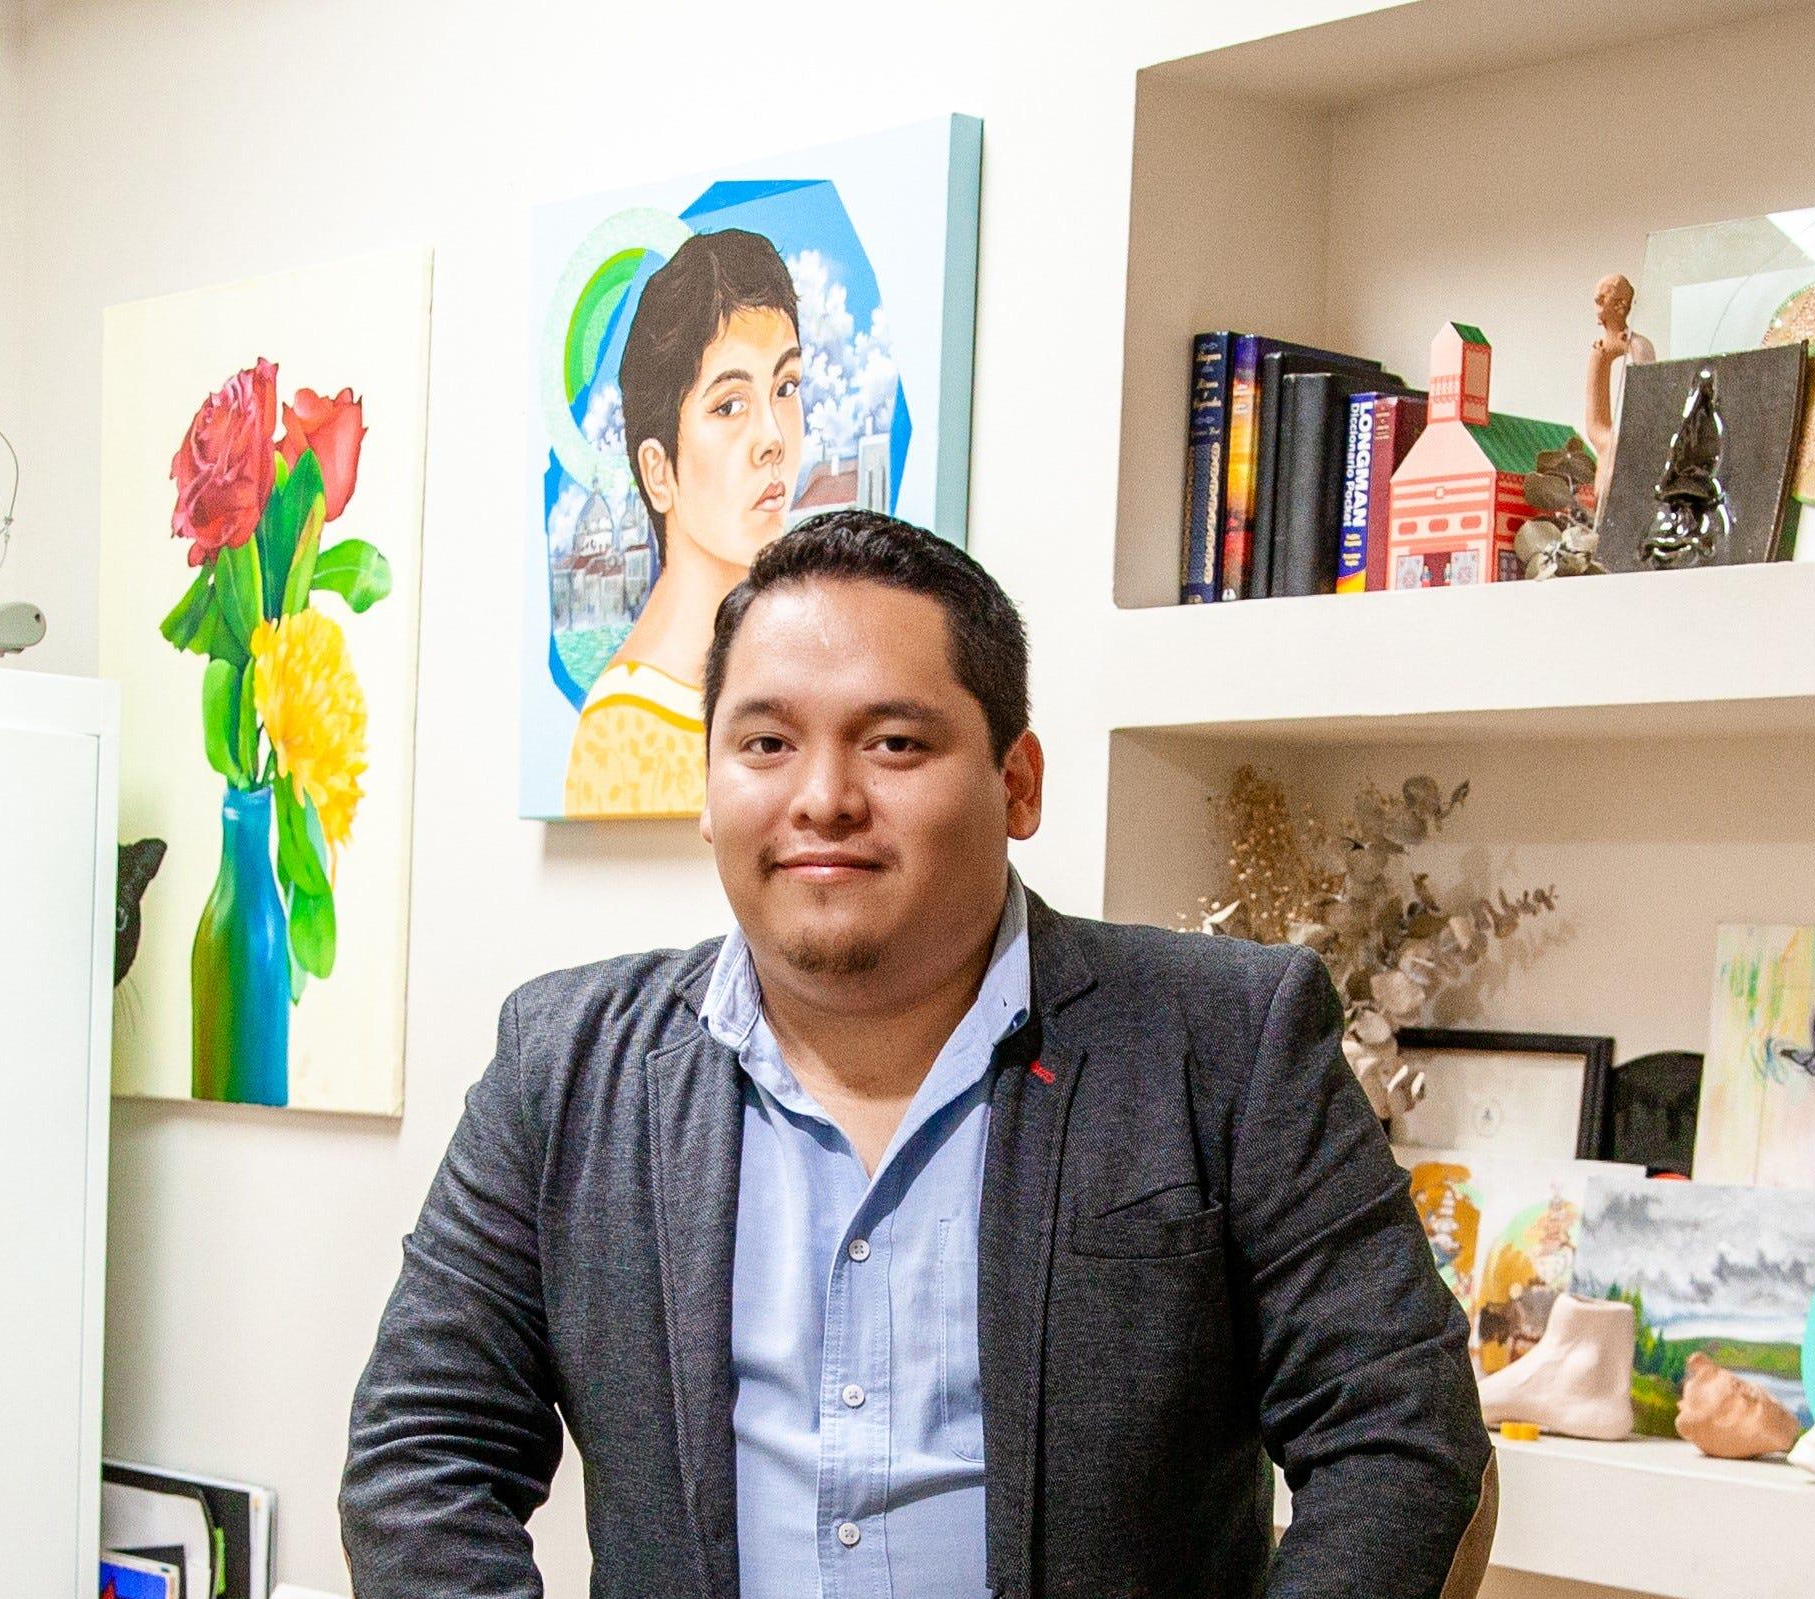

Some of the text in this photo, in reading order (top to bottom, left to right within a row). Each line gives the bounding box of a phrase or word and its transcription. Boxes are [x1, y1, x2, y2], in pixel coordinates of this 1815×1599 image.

[1343, 403, 1360, 526] Diccionario Pocket
[1352, 400, 1374, 527] LONGMAN
